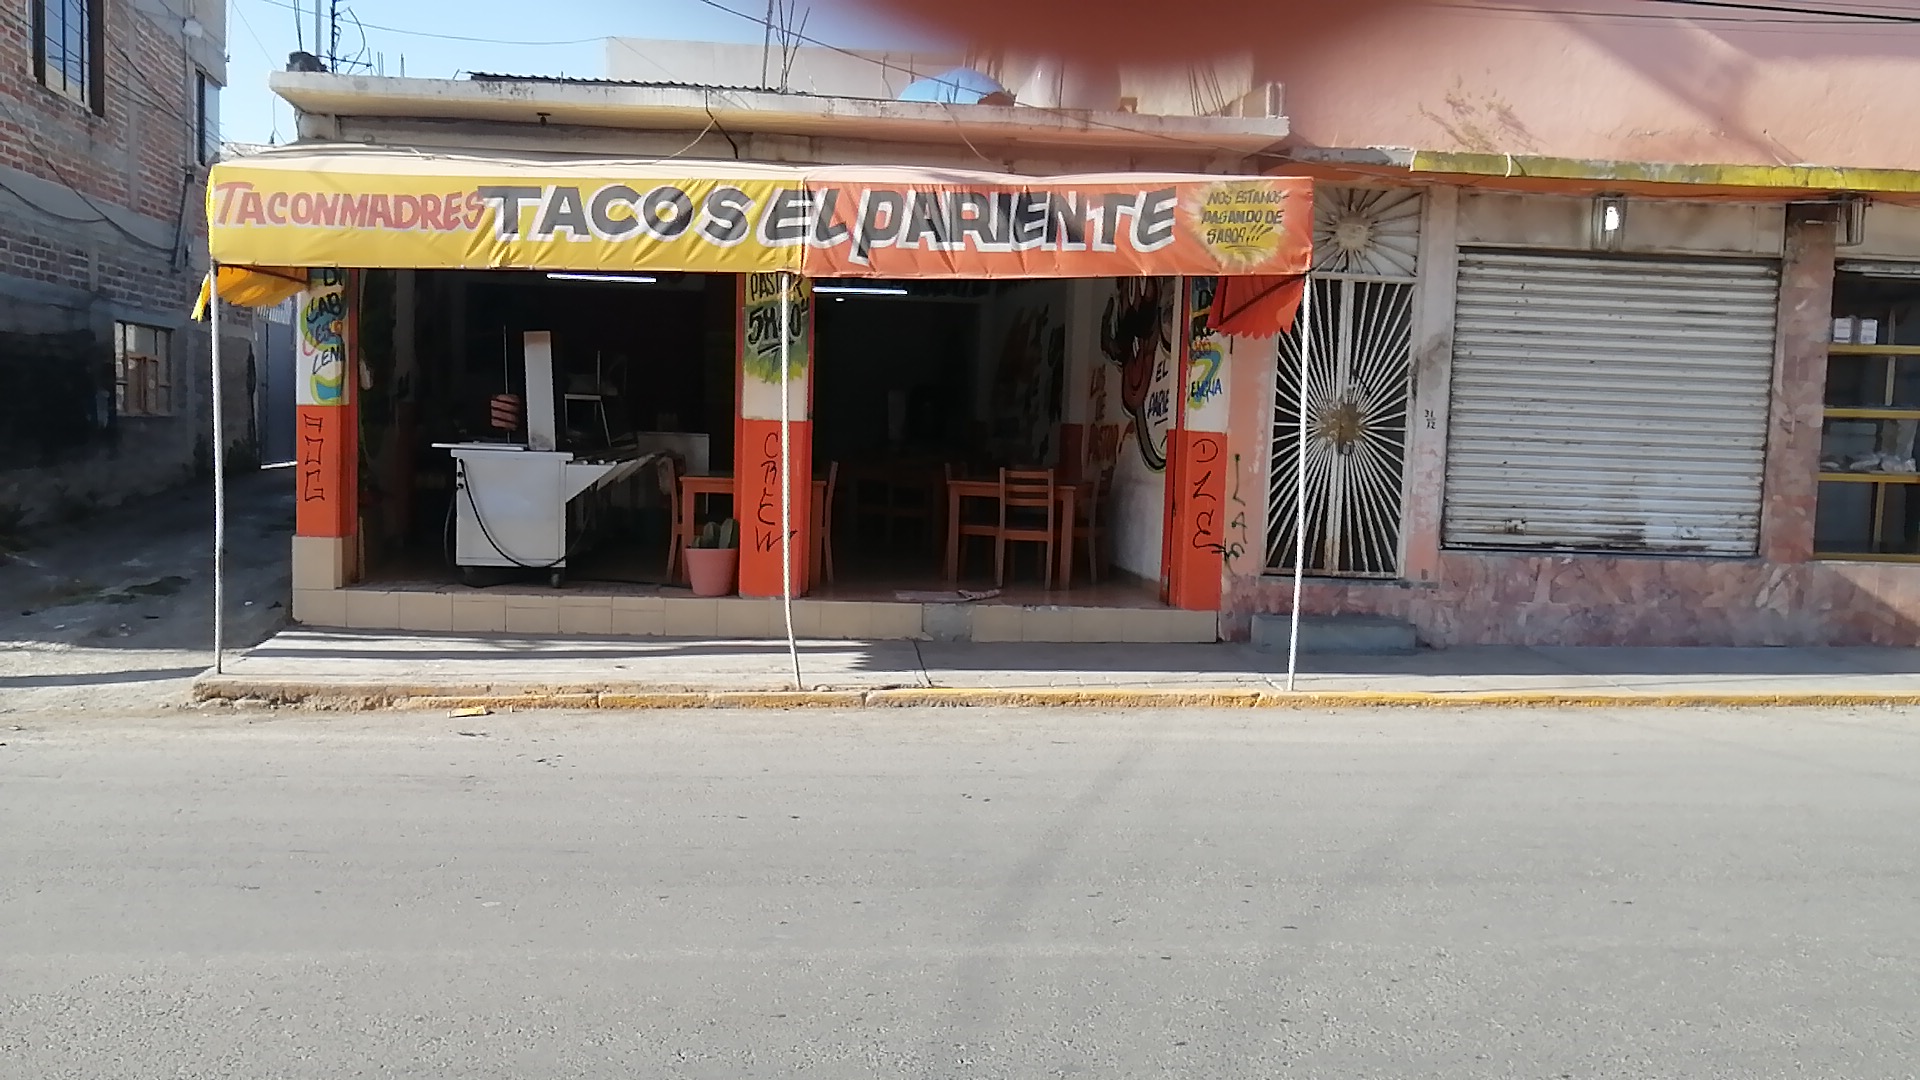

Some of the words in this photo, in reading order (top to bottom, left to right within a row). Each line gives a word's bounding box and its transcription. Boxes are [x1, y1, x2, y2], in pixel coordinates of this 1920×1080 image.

[215, 182, 485, 230] TACONMADRES
[477, 184, 754, 246] TACOS
[756, 187, 850, 248] EL
[848, 185, 1178, 267] PARIENTE
[1202, 210, 1263, 224] PAGANDO
[1265, 209, 1285, 224] DE
